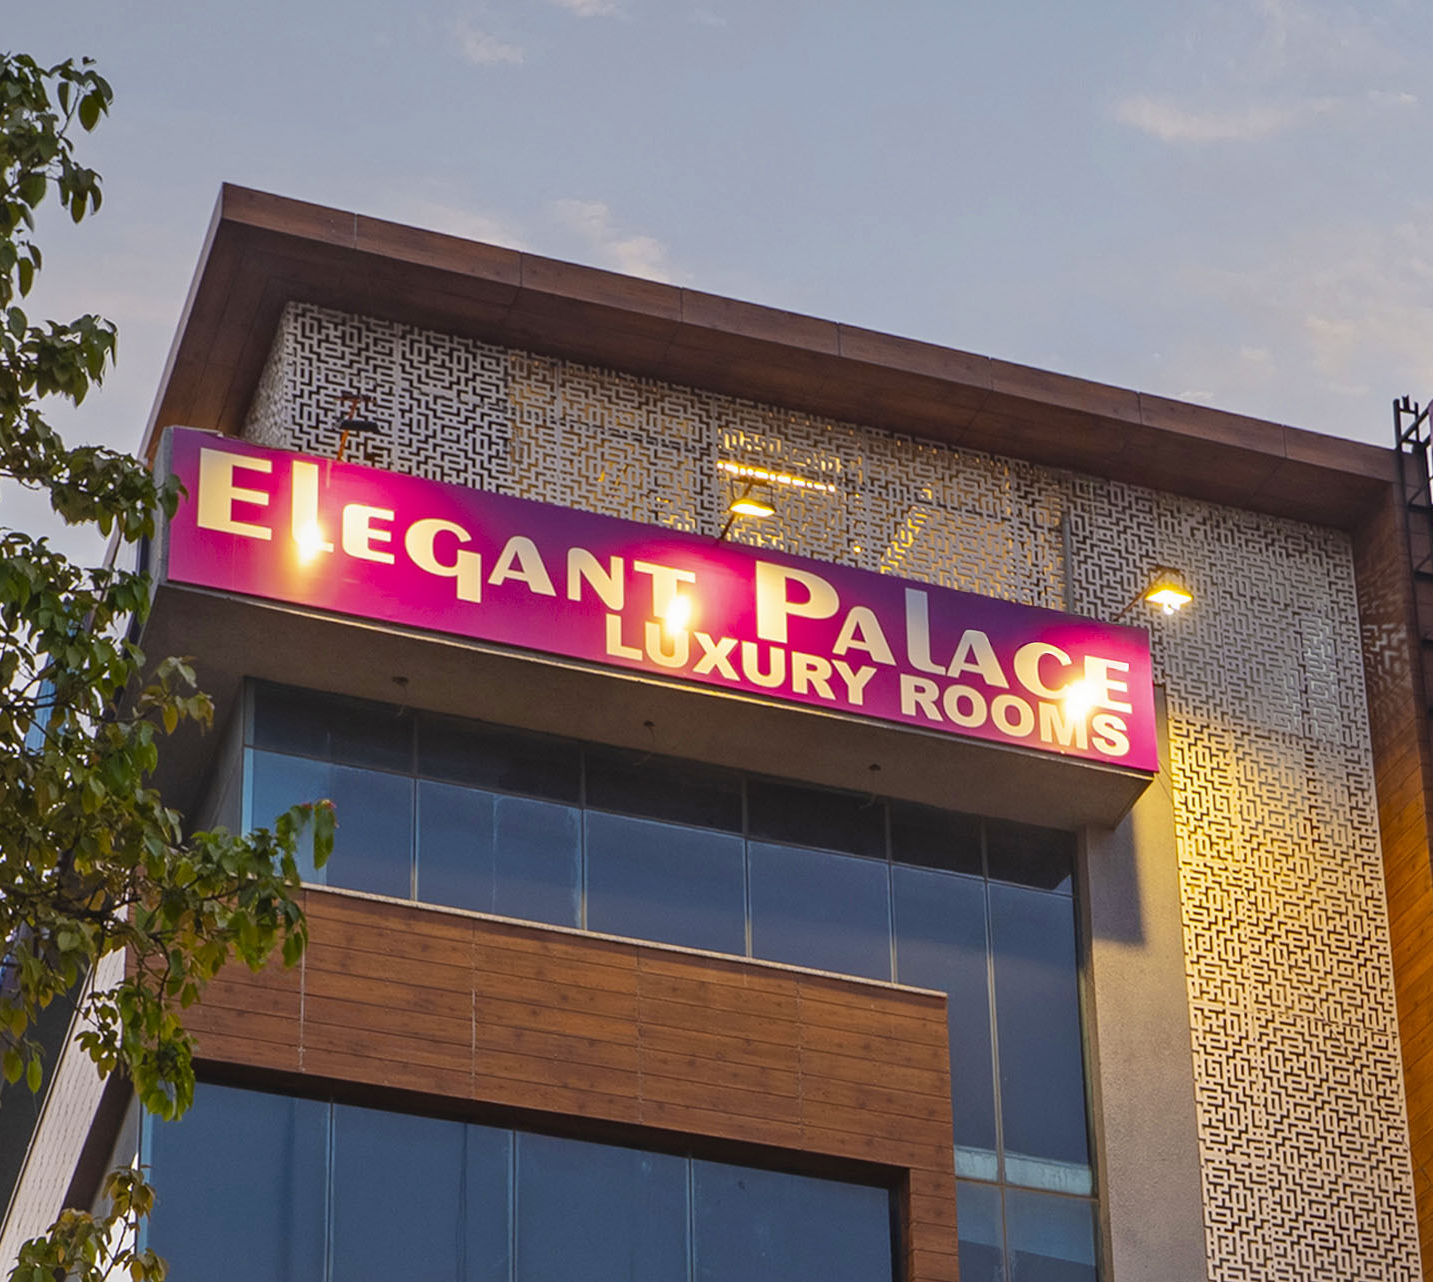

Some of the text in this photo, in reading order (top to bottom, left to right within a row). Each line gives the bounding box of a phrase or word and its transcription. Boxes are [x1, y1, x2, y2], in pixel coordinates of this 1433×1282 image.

[197, 446, 1133, 715] ELEGANT PALACE
[605, 613, 1131, 757] LUXURY ROOMS
